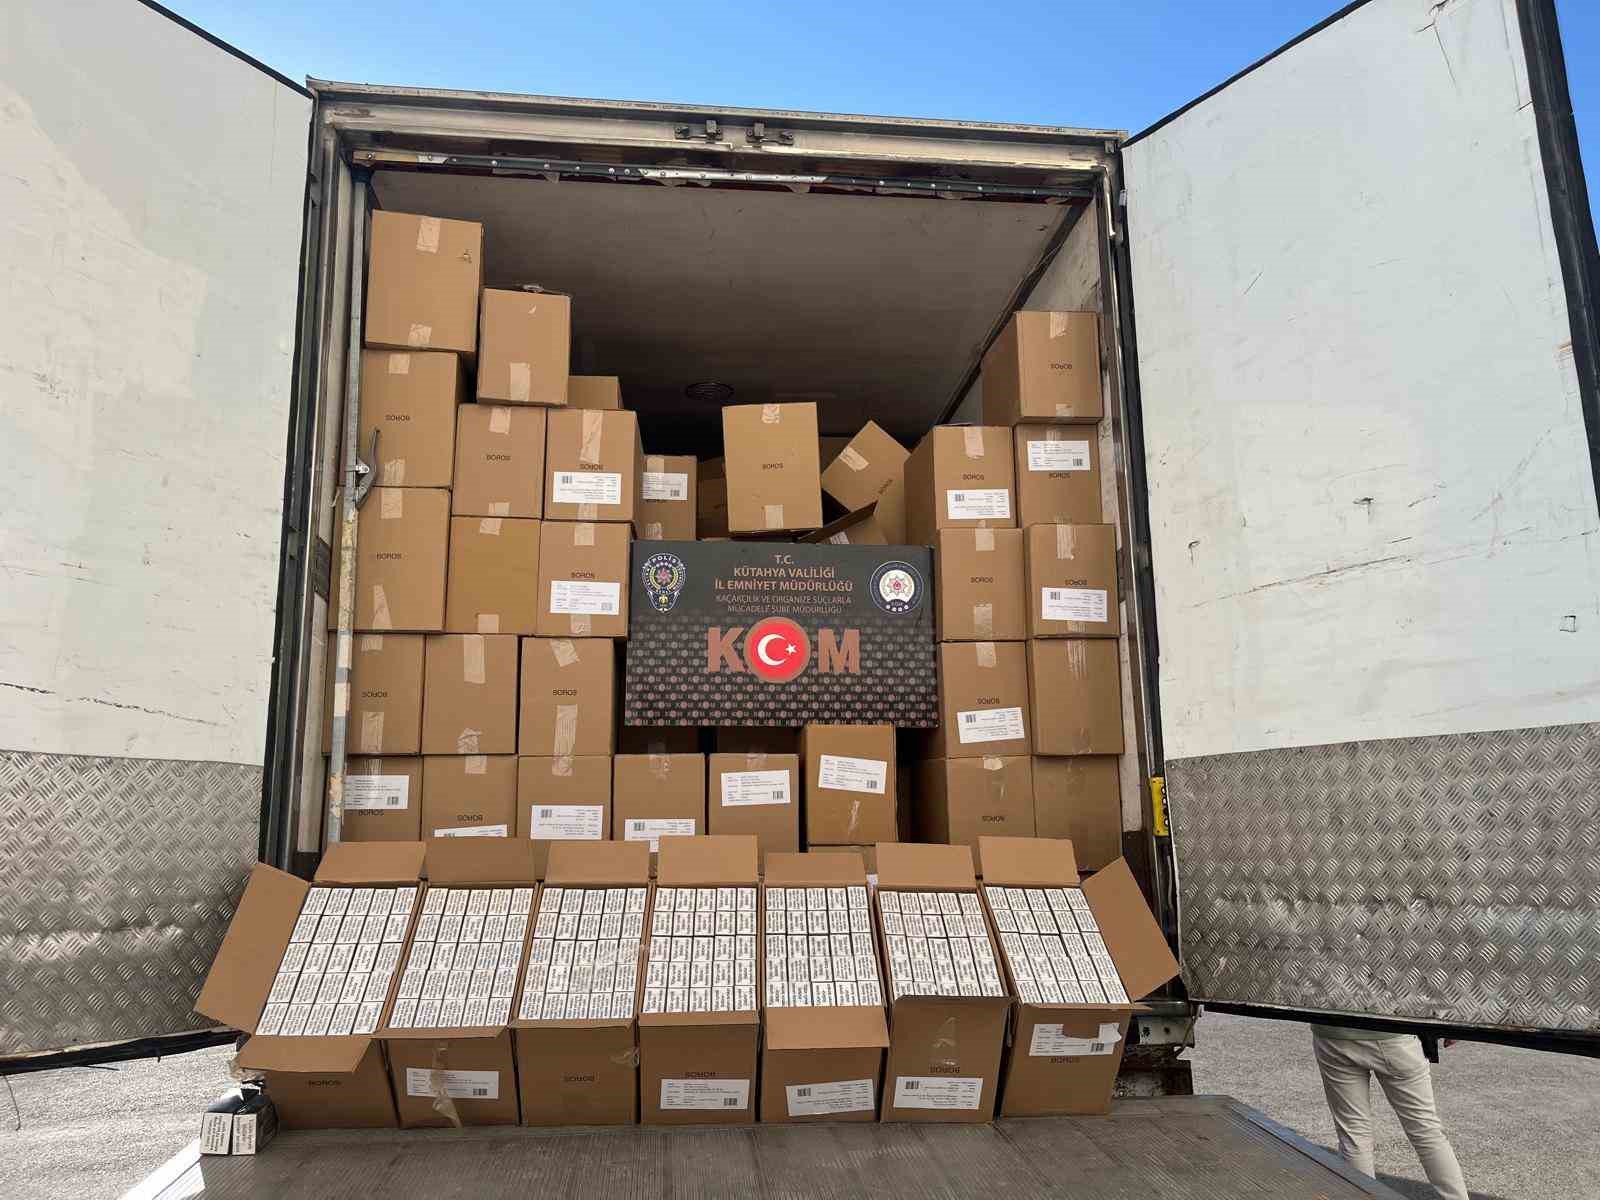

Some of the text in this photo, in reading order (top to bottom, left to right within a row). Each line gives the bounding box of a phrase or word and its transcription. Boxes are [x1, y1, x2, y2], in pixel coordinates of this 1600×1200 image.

[774, 554, 794, 565] T.C.
[734, 565, 835, 578] KÜTAHYA VALİLİĞİ
[714, 578, 853, 592] İL EMNİYET MÜDÜRLÜĞÜ
[761, 595, 771, 603] VE
